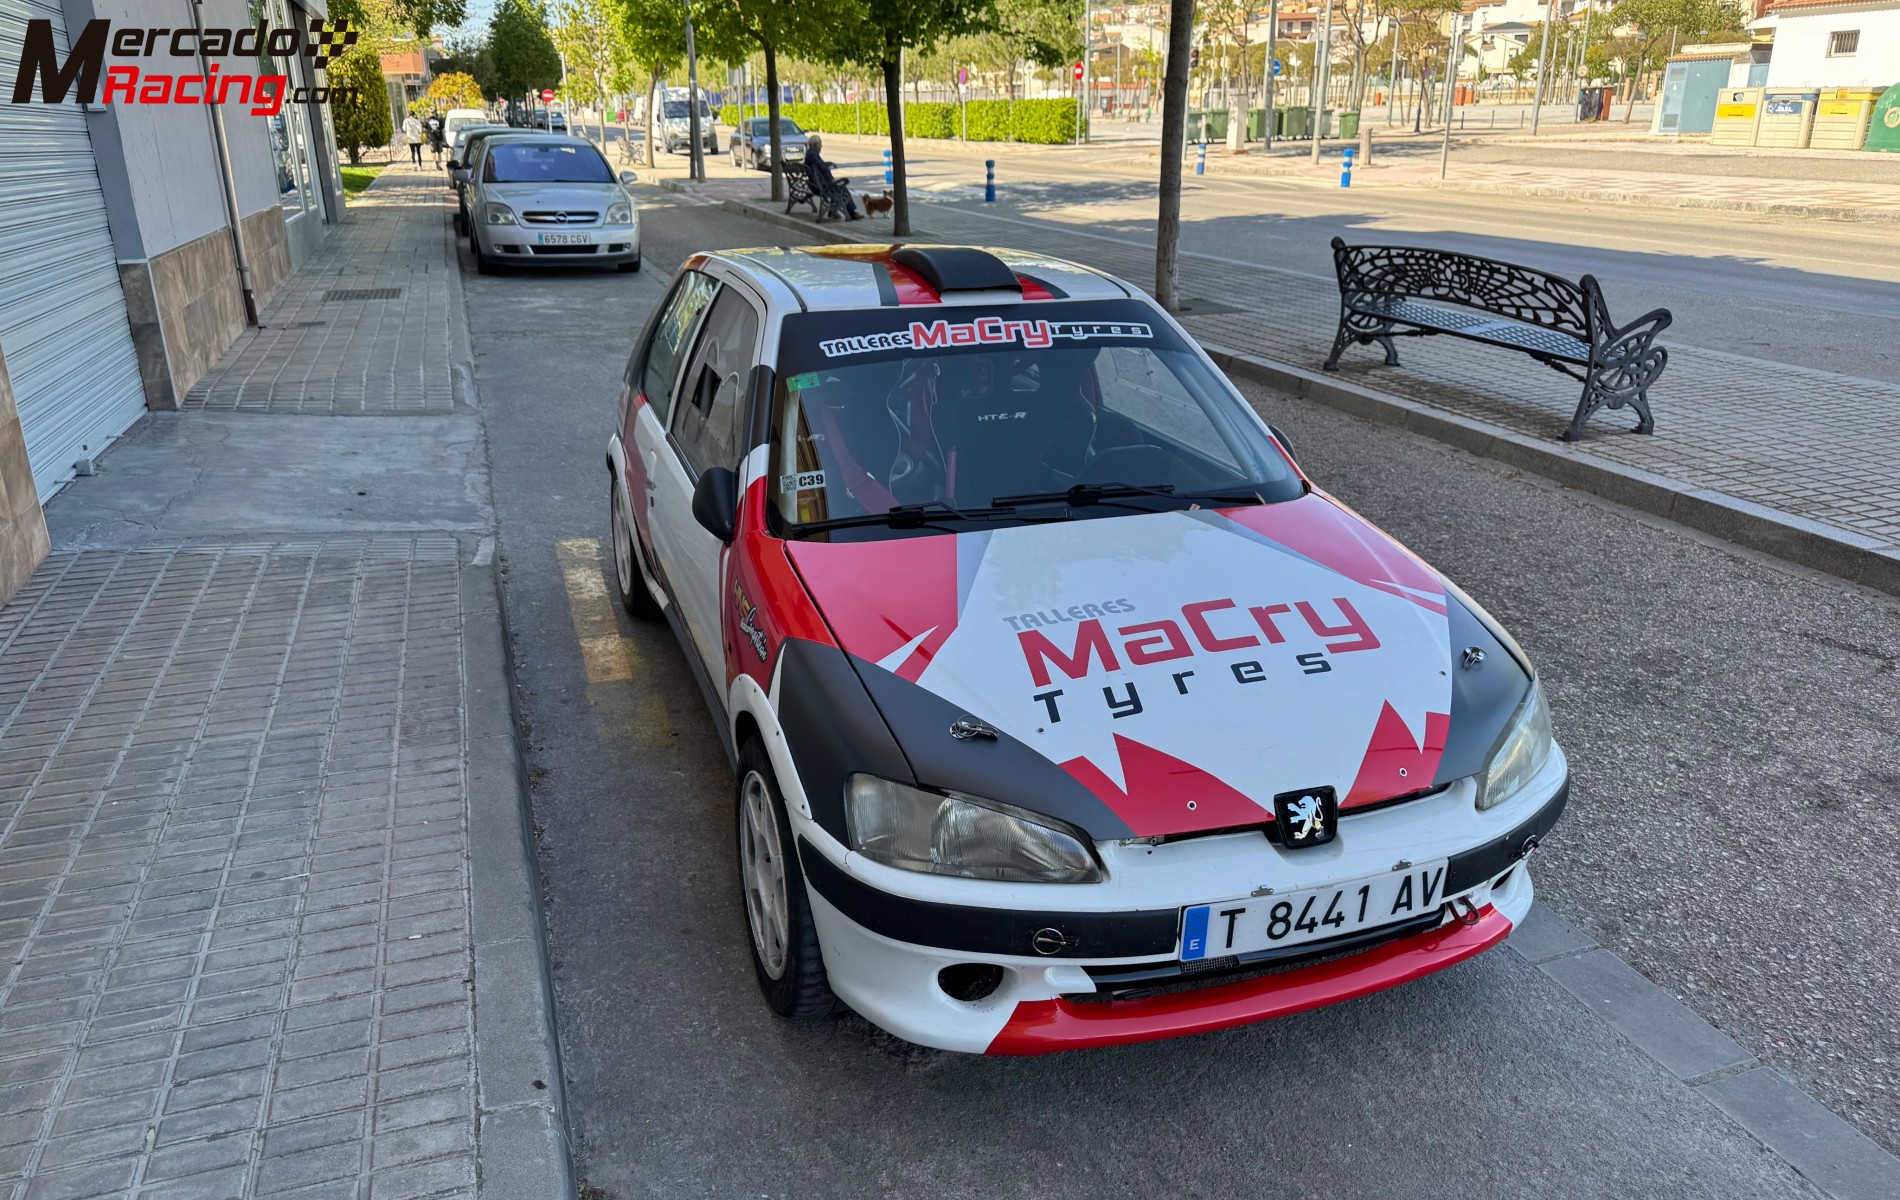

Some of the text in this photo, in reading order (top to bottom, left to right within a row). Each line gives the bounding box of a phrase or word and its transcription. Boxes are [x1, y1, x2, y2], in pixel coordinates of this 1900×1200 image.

[544, 234, 568, 244] 6578
[823, 319, 1142, 355] TALLERES MaCry Tyres
[977, 411, 1027, 422] HTE-R
[798, 473, 824, 487] C39
[1002, 598, 1136, 632] TALLERES
[1017, 597, 1381, 688] MaCry
[1033, 652, 1332, 724] Tyres
[1189, 866, 1445, 951] E T 8441 AV
